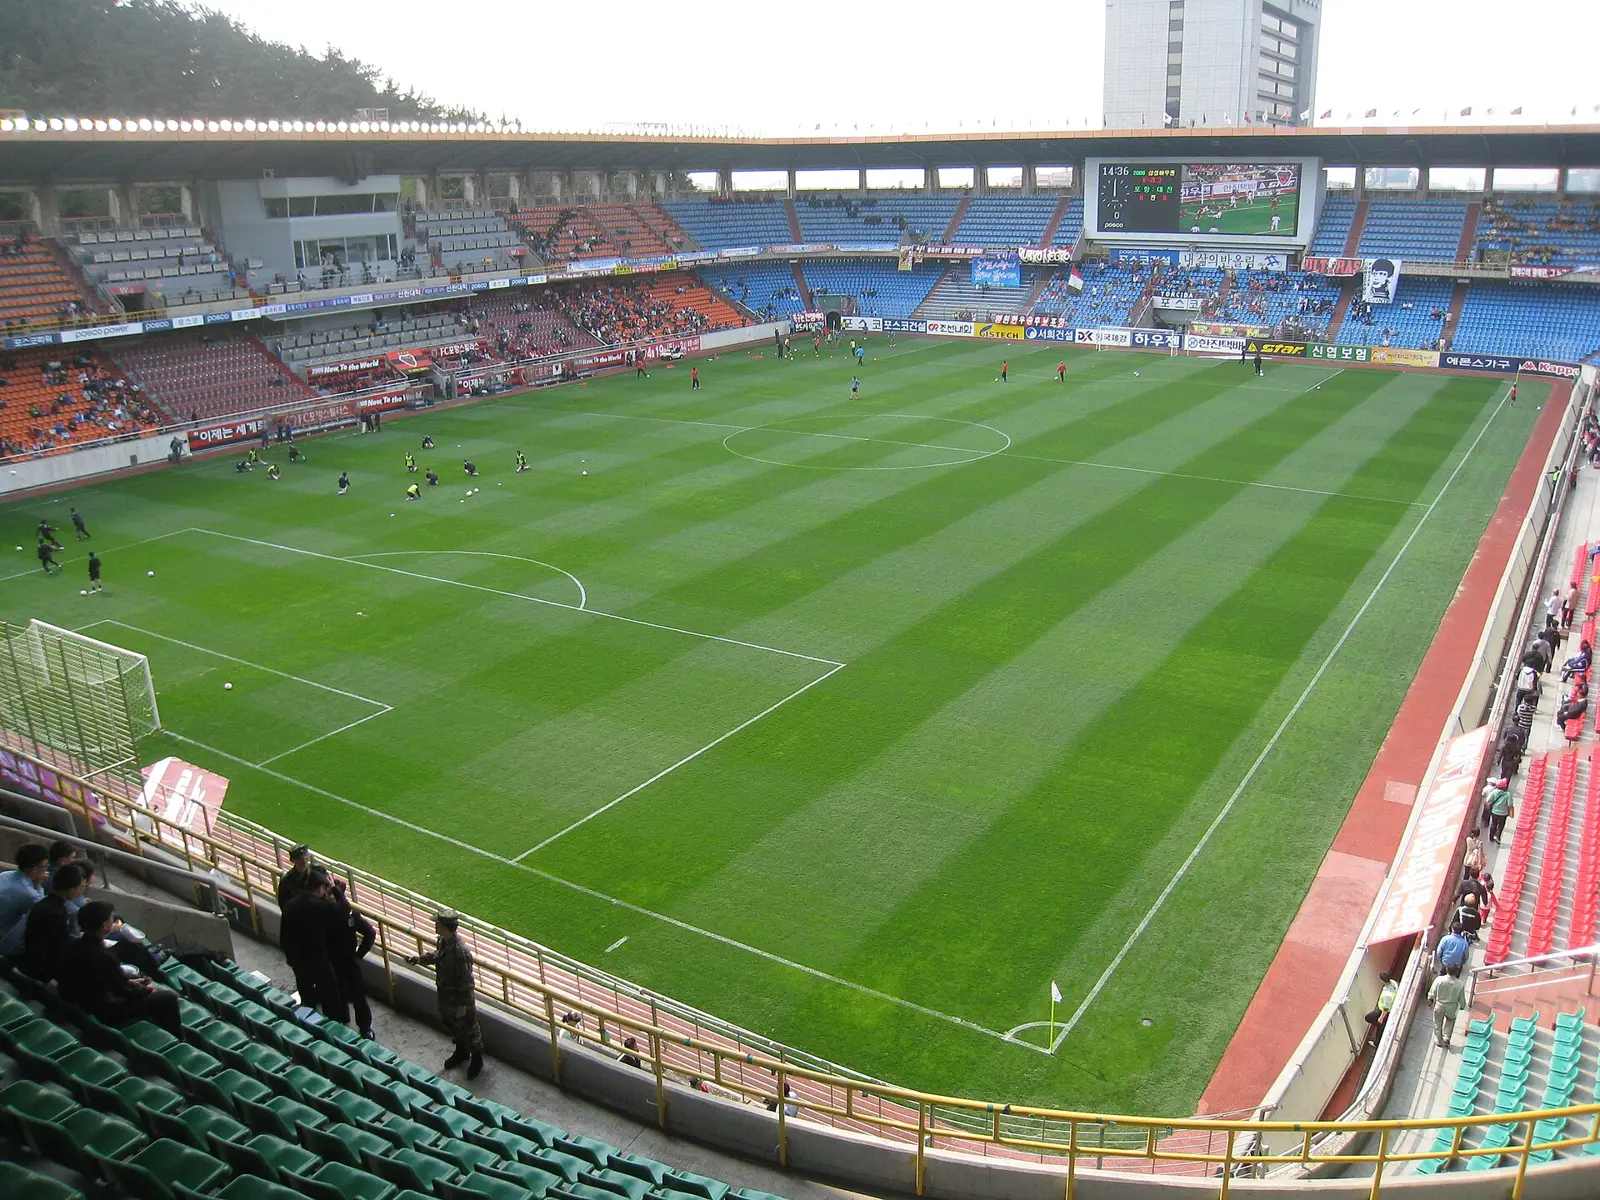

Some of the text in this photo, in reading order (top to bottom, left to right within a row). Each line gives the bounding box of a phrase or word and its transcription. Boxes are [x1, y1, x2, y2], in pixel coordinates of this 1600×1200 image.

[1102, 166, 1129, 176] 14:36
[471, 282, 488, 290] posco
[1160, 298, 1198, 308] 포스코
[207, 313, 230, 322] posco
[145, 320, 170, 331] posco
[883, 319, 927, 332] 포스코건설
[940, 322, 973, 334] 조선내화
[75, 325, 129, 340] posco power
[979, 330, 1019, 339] GISTECH
[1037, 328, 1074, 341] 서희건설
[1134, 332, 1180, 348] 하우젠
[1198, 338, 1245, 351] 한진택배
[1312, 345, 1367, 361] 신협보험
[1538, 361, 1581, 377] Kappa
